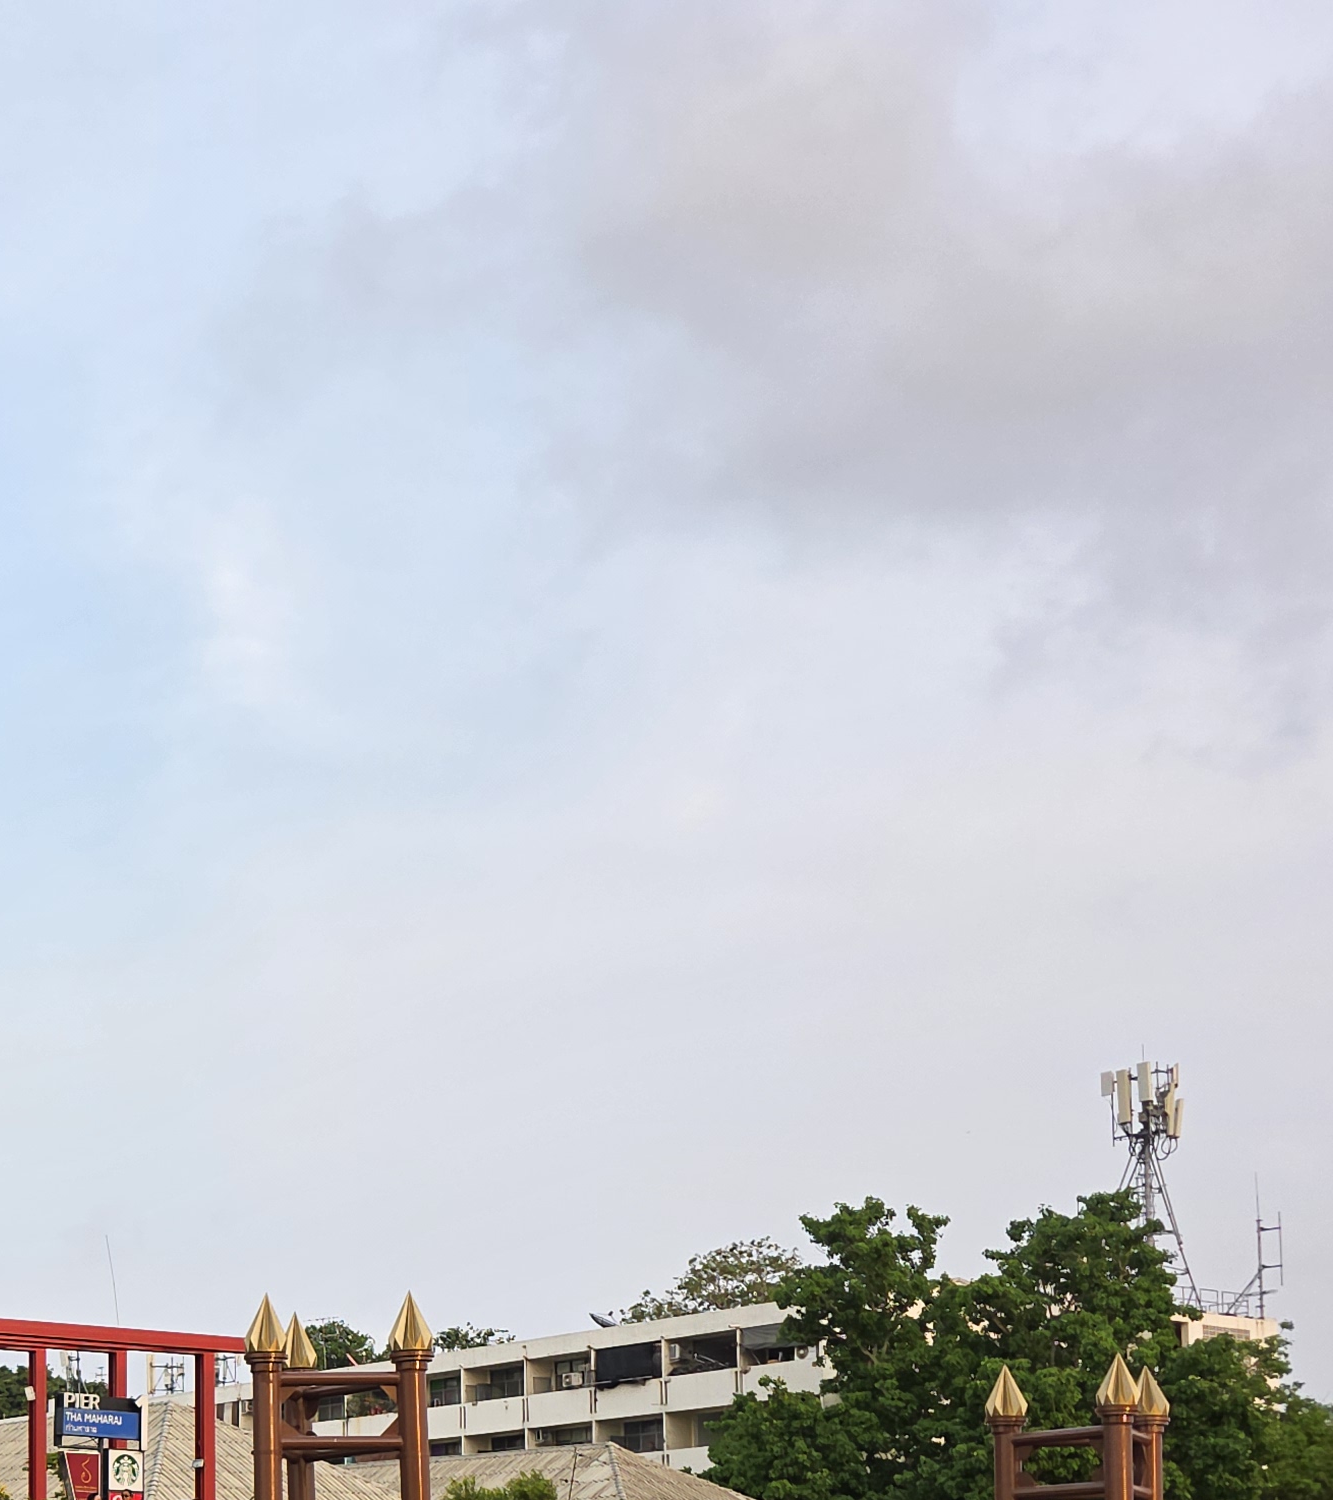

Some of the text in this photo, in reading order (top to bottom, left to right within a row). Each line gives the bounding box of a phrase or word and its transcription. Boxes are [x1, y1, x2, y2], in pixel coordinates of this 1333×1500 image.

[64, 1392, 100, 1410] PIER
[65, 1411, 123, 1425] THA MAHARAJ
